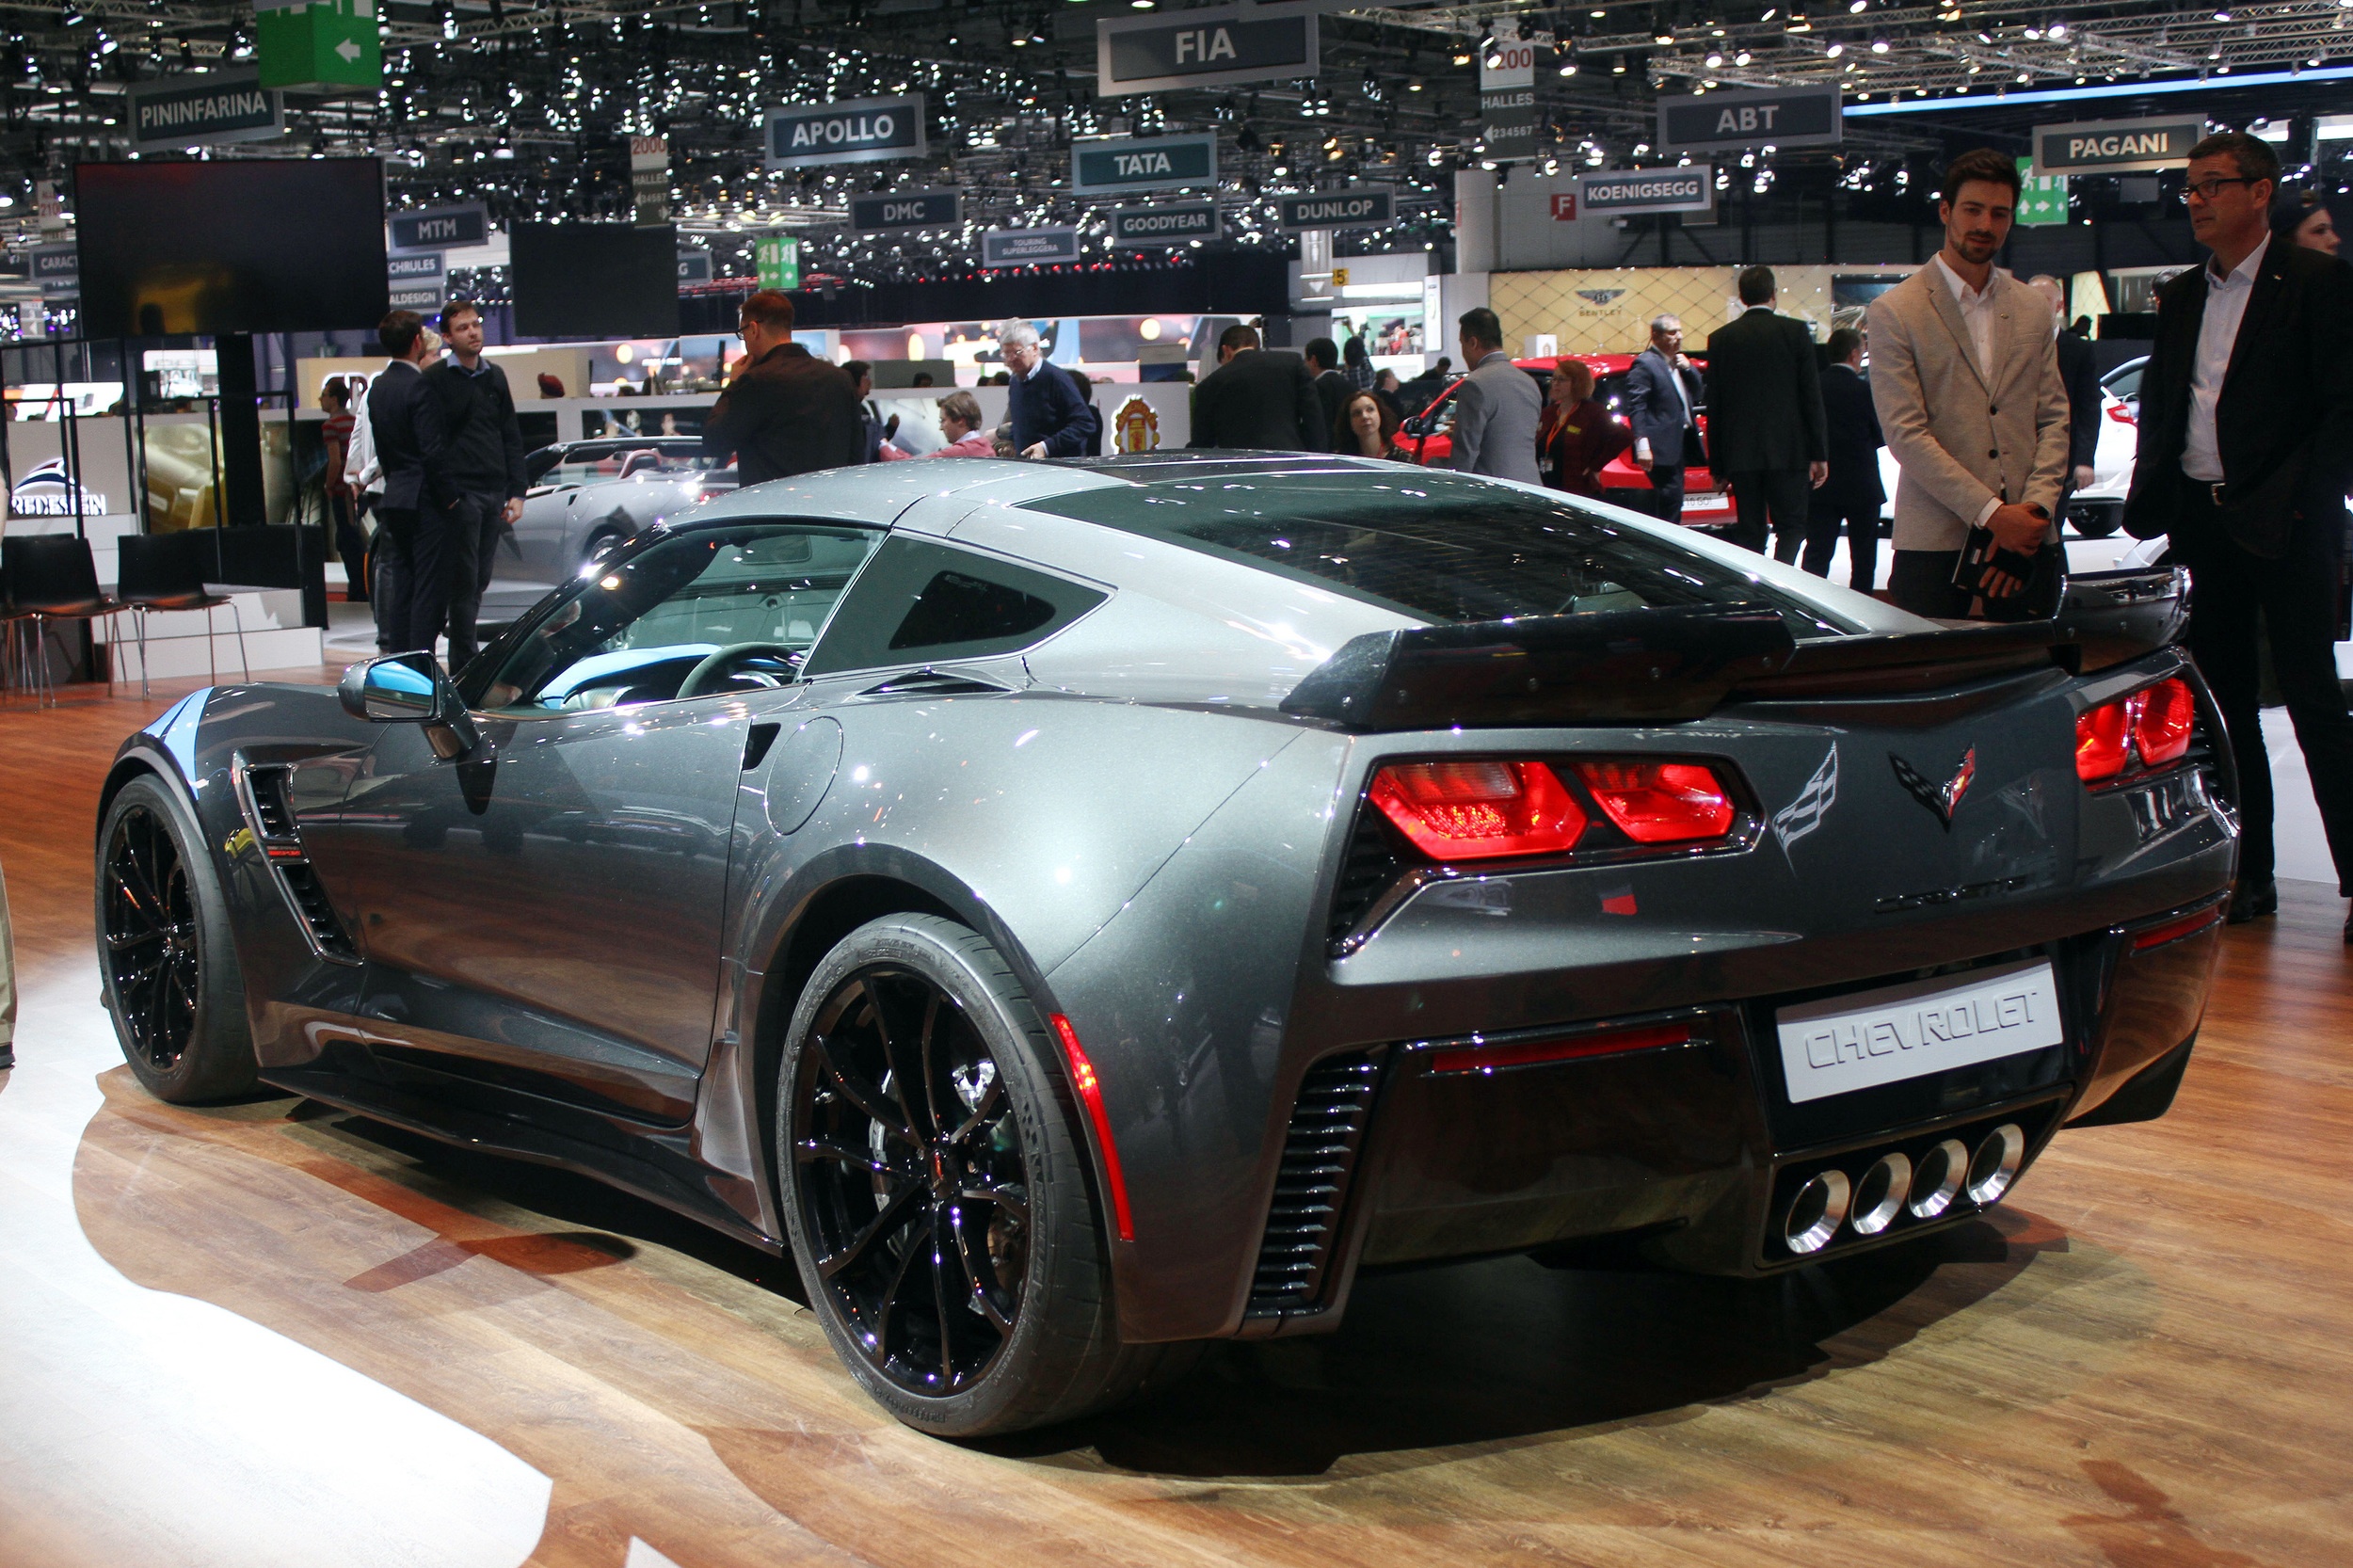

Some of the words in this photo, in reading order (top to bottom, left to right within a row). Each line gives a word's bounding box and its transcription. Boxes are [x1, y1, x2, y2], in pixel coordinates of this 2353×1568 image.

[1176, 28, 1237, 65] FIA
[1484, 47, 1532, 71] 200
[140, 90, 268, 128] PININFARINA
[1481, 92, 1535, 109] HALLES
[1716, 105, 1780, 134] ABT
[791, 114, 894, 148] APOLLO
[1493, 125, 1533, 138] 234567
[632, 136, 667, 154] 2000
[2069, 133, 2169, 159] PAGANI
[1113, 152, 1172, 176] TATA
[632, 173, 668, 185] HALLES
[1588, 182, 1698, 201] KOENIGSEGG
[883, 202, 924, 222] DMC
[1297, 200, 1373, 221] DUNLOP
[1558, 196, 1572, 214] F
[418, 217, 456, 240] MTM
[1124, 213, 1207, 232] GOODYEAR
[1001, 244, 1059, 255] SUPERLEGGERA
[1013, 237, 1047, 247] TOURING
[1578, 309, 1622, 317] BENTLEY
[1804, 990, 2038, 1069] CHEVROLET
